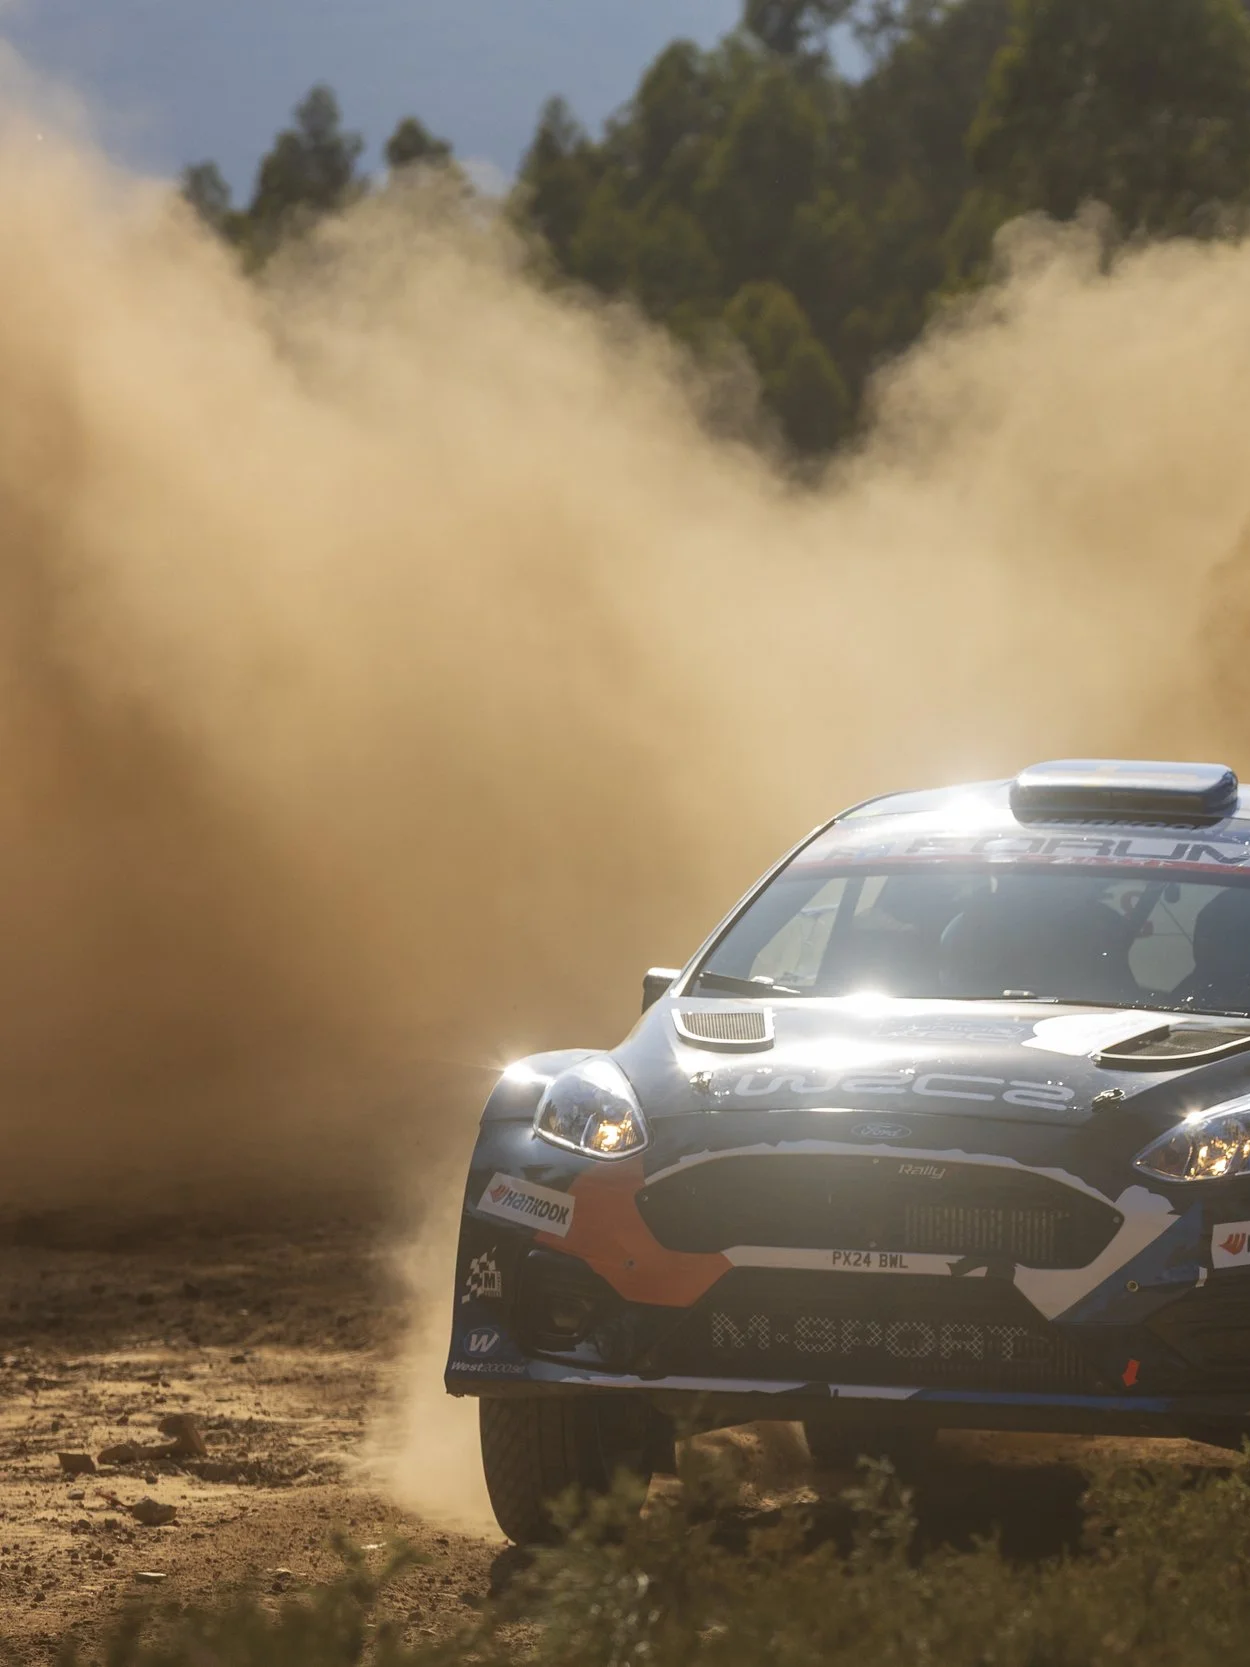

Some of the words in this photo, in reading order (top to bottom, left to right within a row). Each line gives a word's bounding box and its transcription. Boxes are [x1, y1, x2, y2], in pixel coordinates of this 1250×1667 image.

[898, 1163, 946, 1179] Rally
[832, 1251, 871, 1269] PX24
[879, 1253, 908, 1269] BWL
